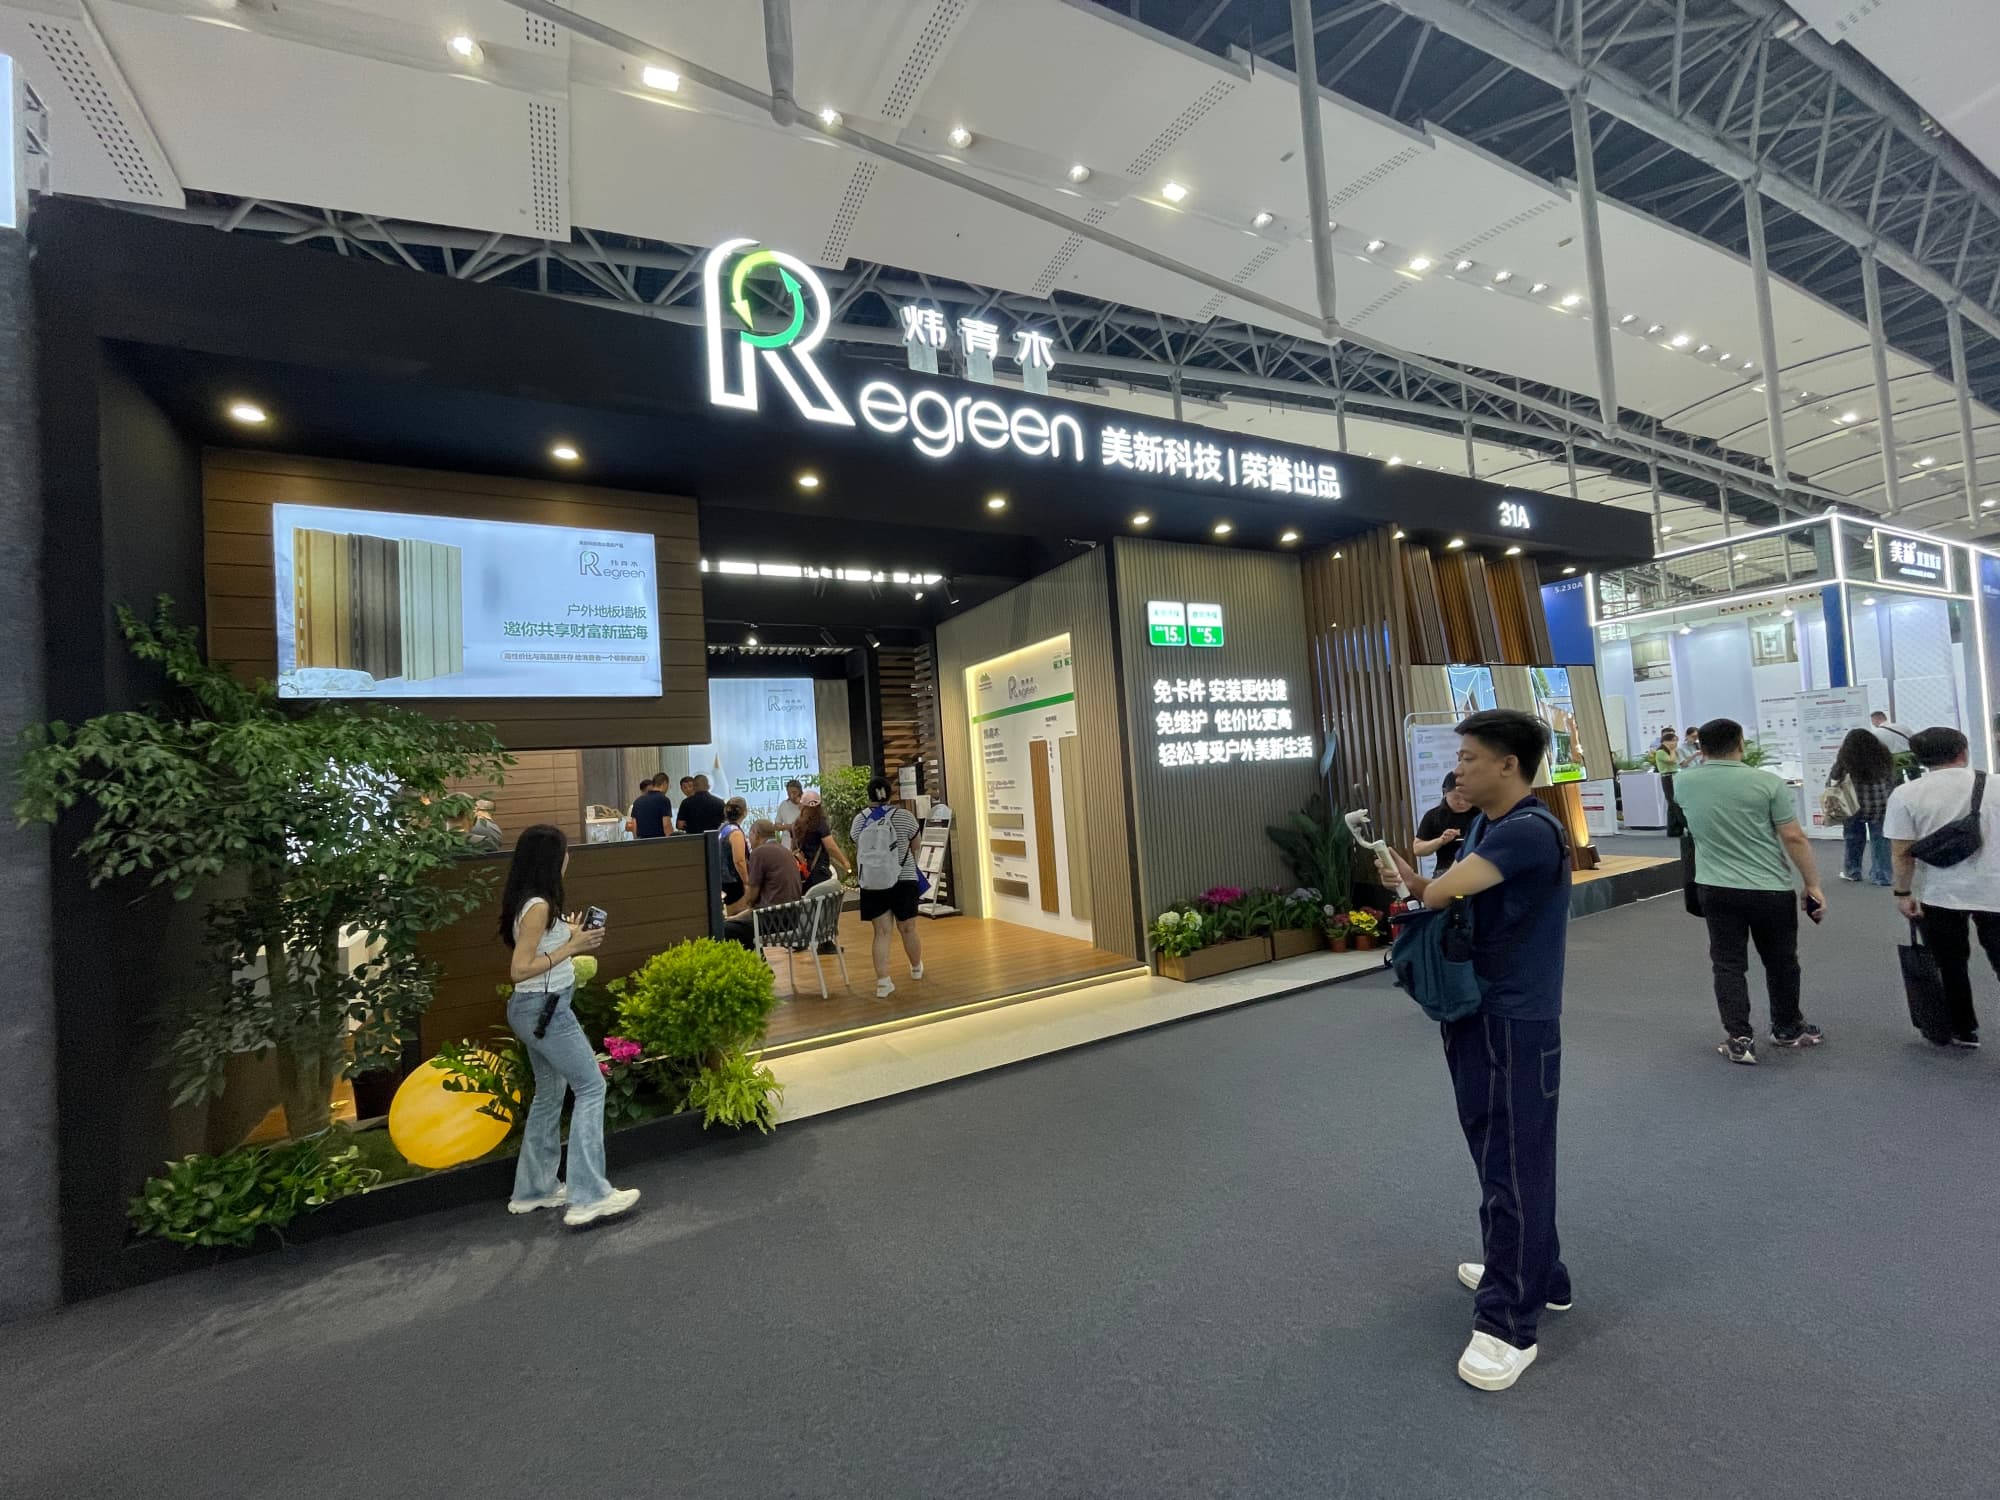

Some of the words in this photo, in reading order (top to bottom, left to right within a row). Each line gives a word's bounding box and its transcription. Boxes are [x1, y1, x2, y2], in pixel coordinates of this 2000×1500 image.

[704, 238, 1085, 463] Regreen
[1498, 500, 1530, 529] 31A
[579, 551, 646, 580] Regreen
[567, 603, 647, 619] 户外地板墙板
[503, 621, 648, 640] 邀你共享财富新蓝海
[1153, 678, 1206, 703] 免卡件
[1155, 709, 1208, 735] 免维护
[1214, 708, 1293, 733] 性价比更高
[763, 738, 808, 752] 新品首发
[1158, 736, 1313, 767] 轻松享受户外美新生活
[748, 754, 809, 773] 抢占先机
